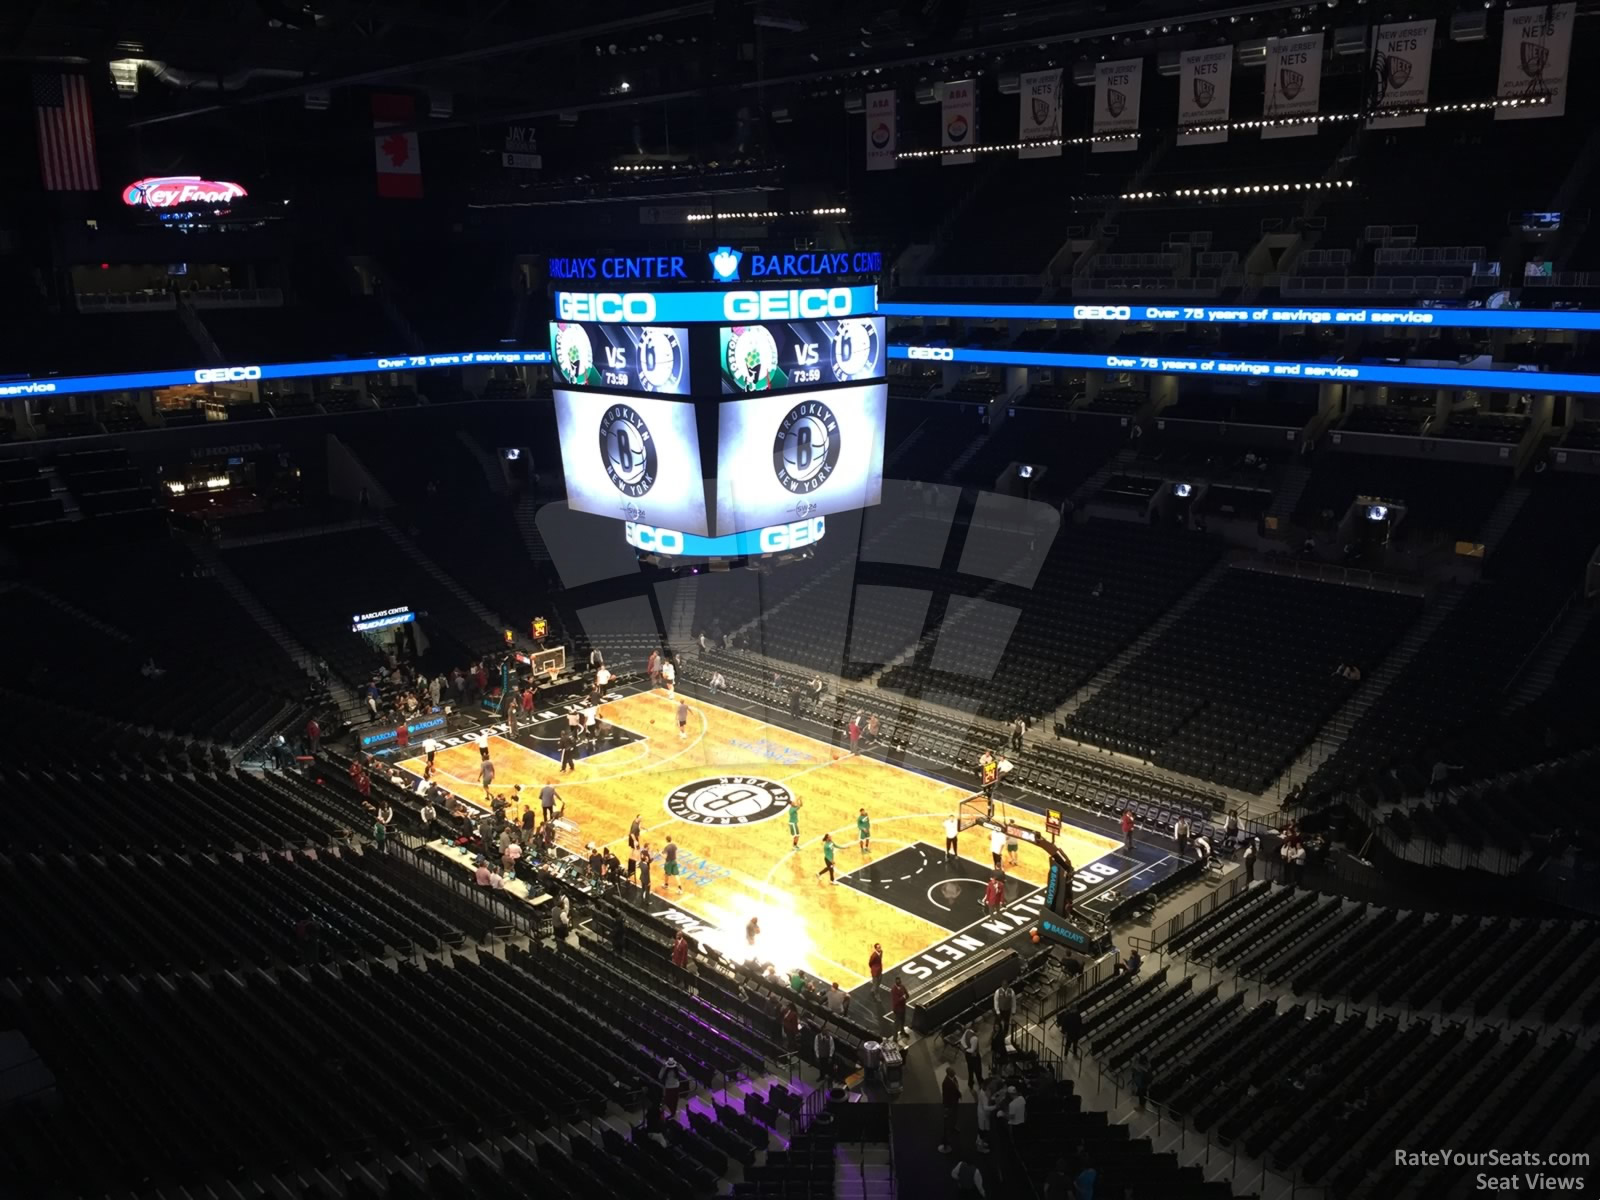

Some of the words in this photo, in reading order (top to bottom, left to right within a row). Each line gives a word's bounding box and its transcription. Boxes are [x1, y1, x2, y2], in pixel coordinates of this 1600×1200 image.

[1513, 15, 1532, 24] NEW
[1534, 11, 1568, 22] JEEY
[1380, 32, 1397, 40] NEW
[1399, 28, 1429, 38] JERSEY
[1522, 25, 1554, 38] NETS
[1291, 41, 1317, 50] JERSEY
[1388, 40, 1417, 52] NETS
[1187, 57, 1203, 65] NEW
[1203, 53, 1227, 62] JERSEY
[1281, 53, 1307, 66] NETS
[1194, 64, 1218, 75] NETS
[1108, 75, 1129, 86] NETS
[950, 90, 967, 99] ABA
[1032, 85, 1051, 95] NETS
[873, 99, 889, 108] ABA
[505, 126, 526, 141] JAY
[528, 127, 536, 142] Z
[136, 184, 178, 207] Key
[601, 256, 688, 279] CENTER
[751, 253, 849, 277] BARCLAYS
[559, 292, 656, 322] GEICO
[723, 287, 852, 321] GEICO
[1073, 306, 1131, 320] GEICO
[1146, 308, 1179, 319] Over
[1184, 308, 1204, 319] 75
[1208, 310, 1248, 321] years
[1252, 309, 1268, 320] of
[1272, 309, 1331, 323] savings
[1336, 310, 1366, 322] and
[1371, 311, 1433, 323] service
[378, 359, 406, 368] Over
[409, 356, 426, 366] 75
[429, 356, 459, 367] years
[462, 353, 473, 362] of
[476, 352, 520, 363] savings
[523, 352, 545, 361] and
[605, 346, 627, 369] VS
[794, 343, 819, 366] VS
[908, 346, 953, 360] GEICO
[1107, 356, 1136, 367] Over
[1140, 358, 1158, 368] 75
[1162, 359, 1197, 370] years
[1200, 361, 1214, 370] of
[1218, 361, 1270, 375] savings
[1274, 364, 1301, 375] and
[1304, 366, 1359, 378] service
[195, 366, 261, 383] GEICO
[793, 369, 820, 383] 73:59
[0, 382, 55, 396] service
[601, 406, 650, 441] BROOKLYN
[778, 403, 836, 440] BROOKLYN
[617, 429, 633, 472] B
[797, 426, 812, 471] B
[607, 466, 626, 491] NEW
[630, 473, 653, 495] YORK
[778, 468, 799, 492] NEW
[804, 463, 832, 492] YORK
[361, 610, 388, 620] BARCLAYS
[387, 605, 409, 615] CENTER
[415, 717, 444, 731] BARCLAYS
[719, 777, 768, 789] YORK
[670, 790, 749, 824] BROOKLYN
[703, 789, 758, 811] B
[1046, 870, 1057, 905] BARCLAYS
[1051, 924, 1085, 944] BARCLAYS
[901, 934, 985, 980] NETS
